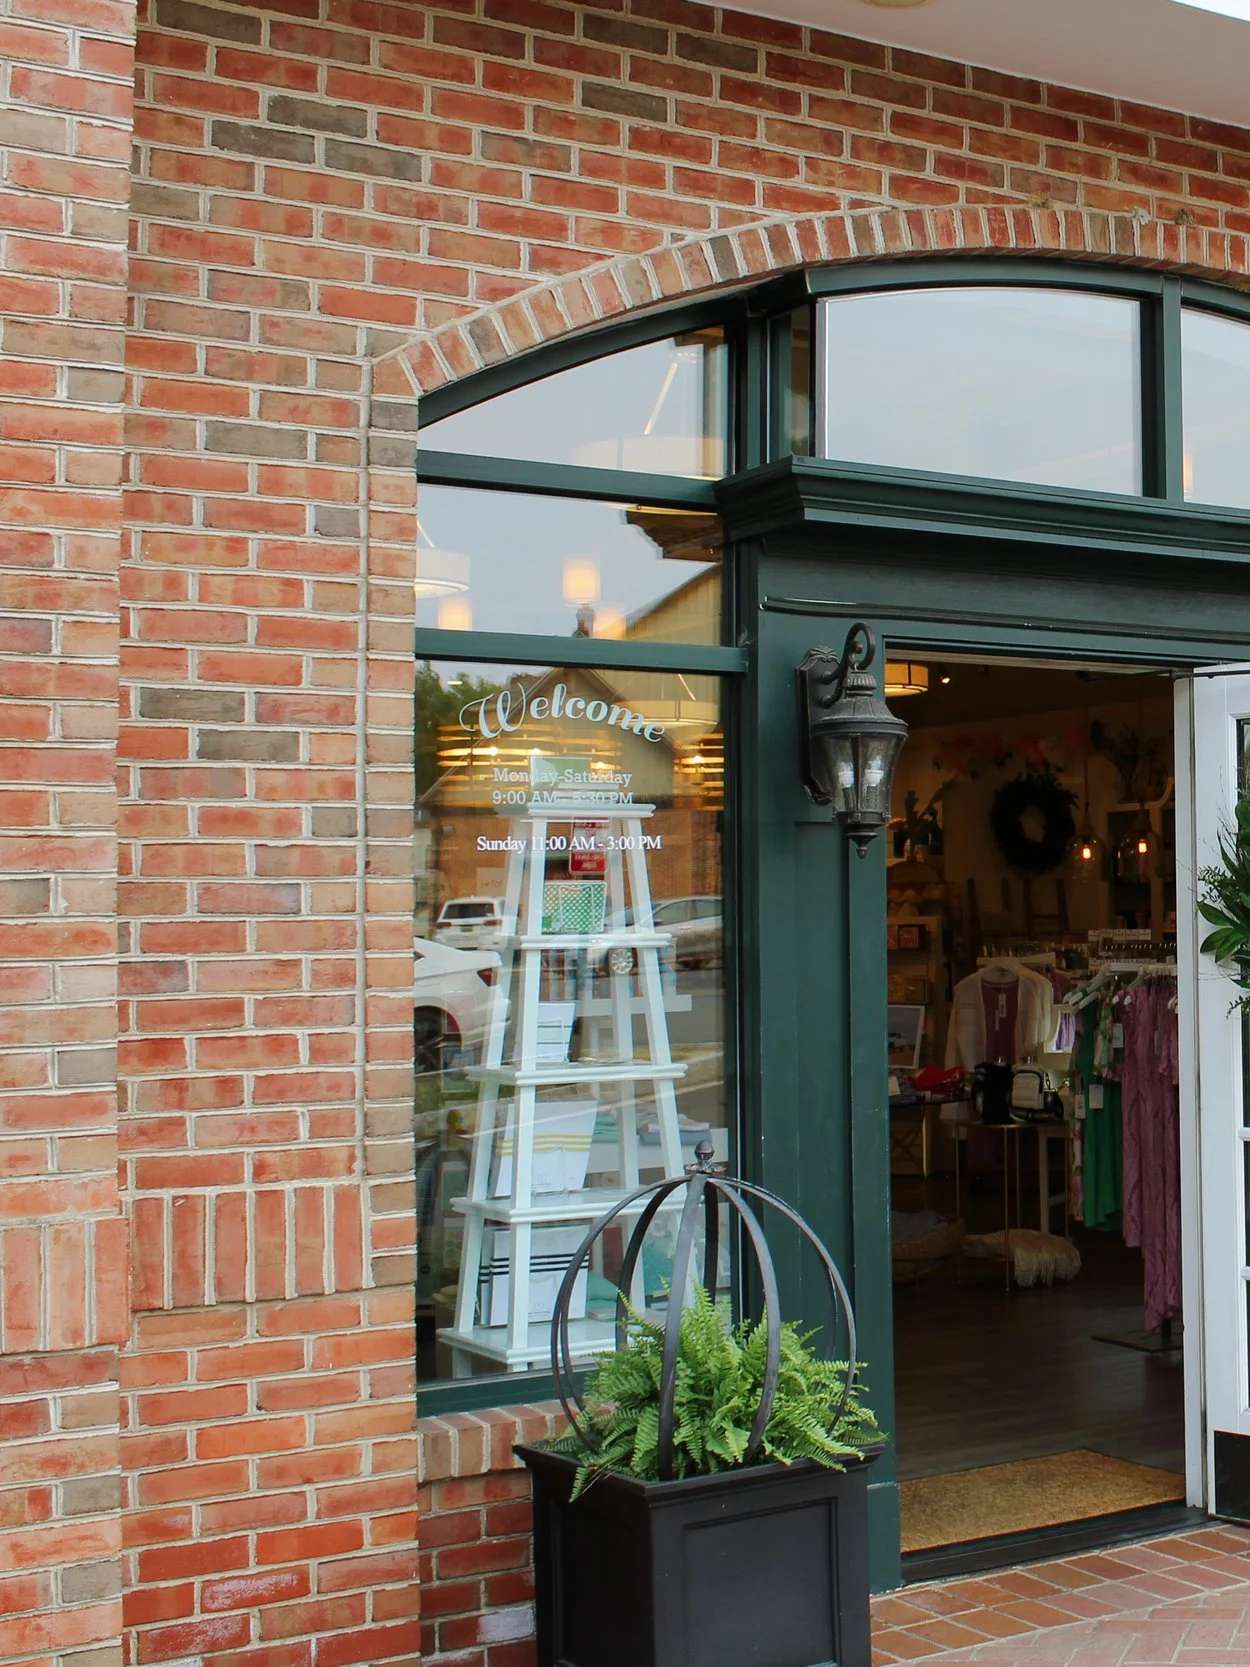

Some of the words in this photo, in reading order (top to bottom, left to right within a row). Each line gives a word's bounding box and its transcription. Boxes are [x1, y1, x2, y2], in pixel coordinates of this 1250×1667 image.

[459, 683, 666, 743] Welcome
[493, 767, 633, 788] Monday-Saturday
[492, 790, 526, 805] 9:00
[532, 791, 558, 805] AM
[610, 792, 634, 805] PM
[476, 836, 527, 854] Sunday
[532, 835, 567, 851] 11:00
[568, 835, 596, 850] AM
[607, 835, 635, 851] 3:00
[638, 835, 663, 850] PM
